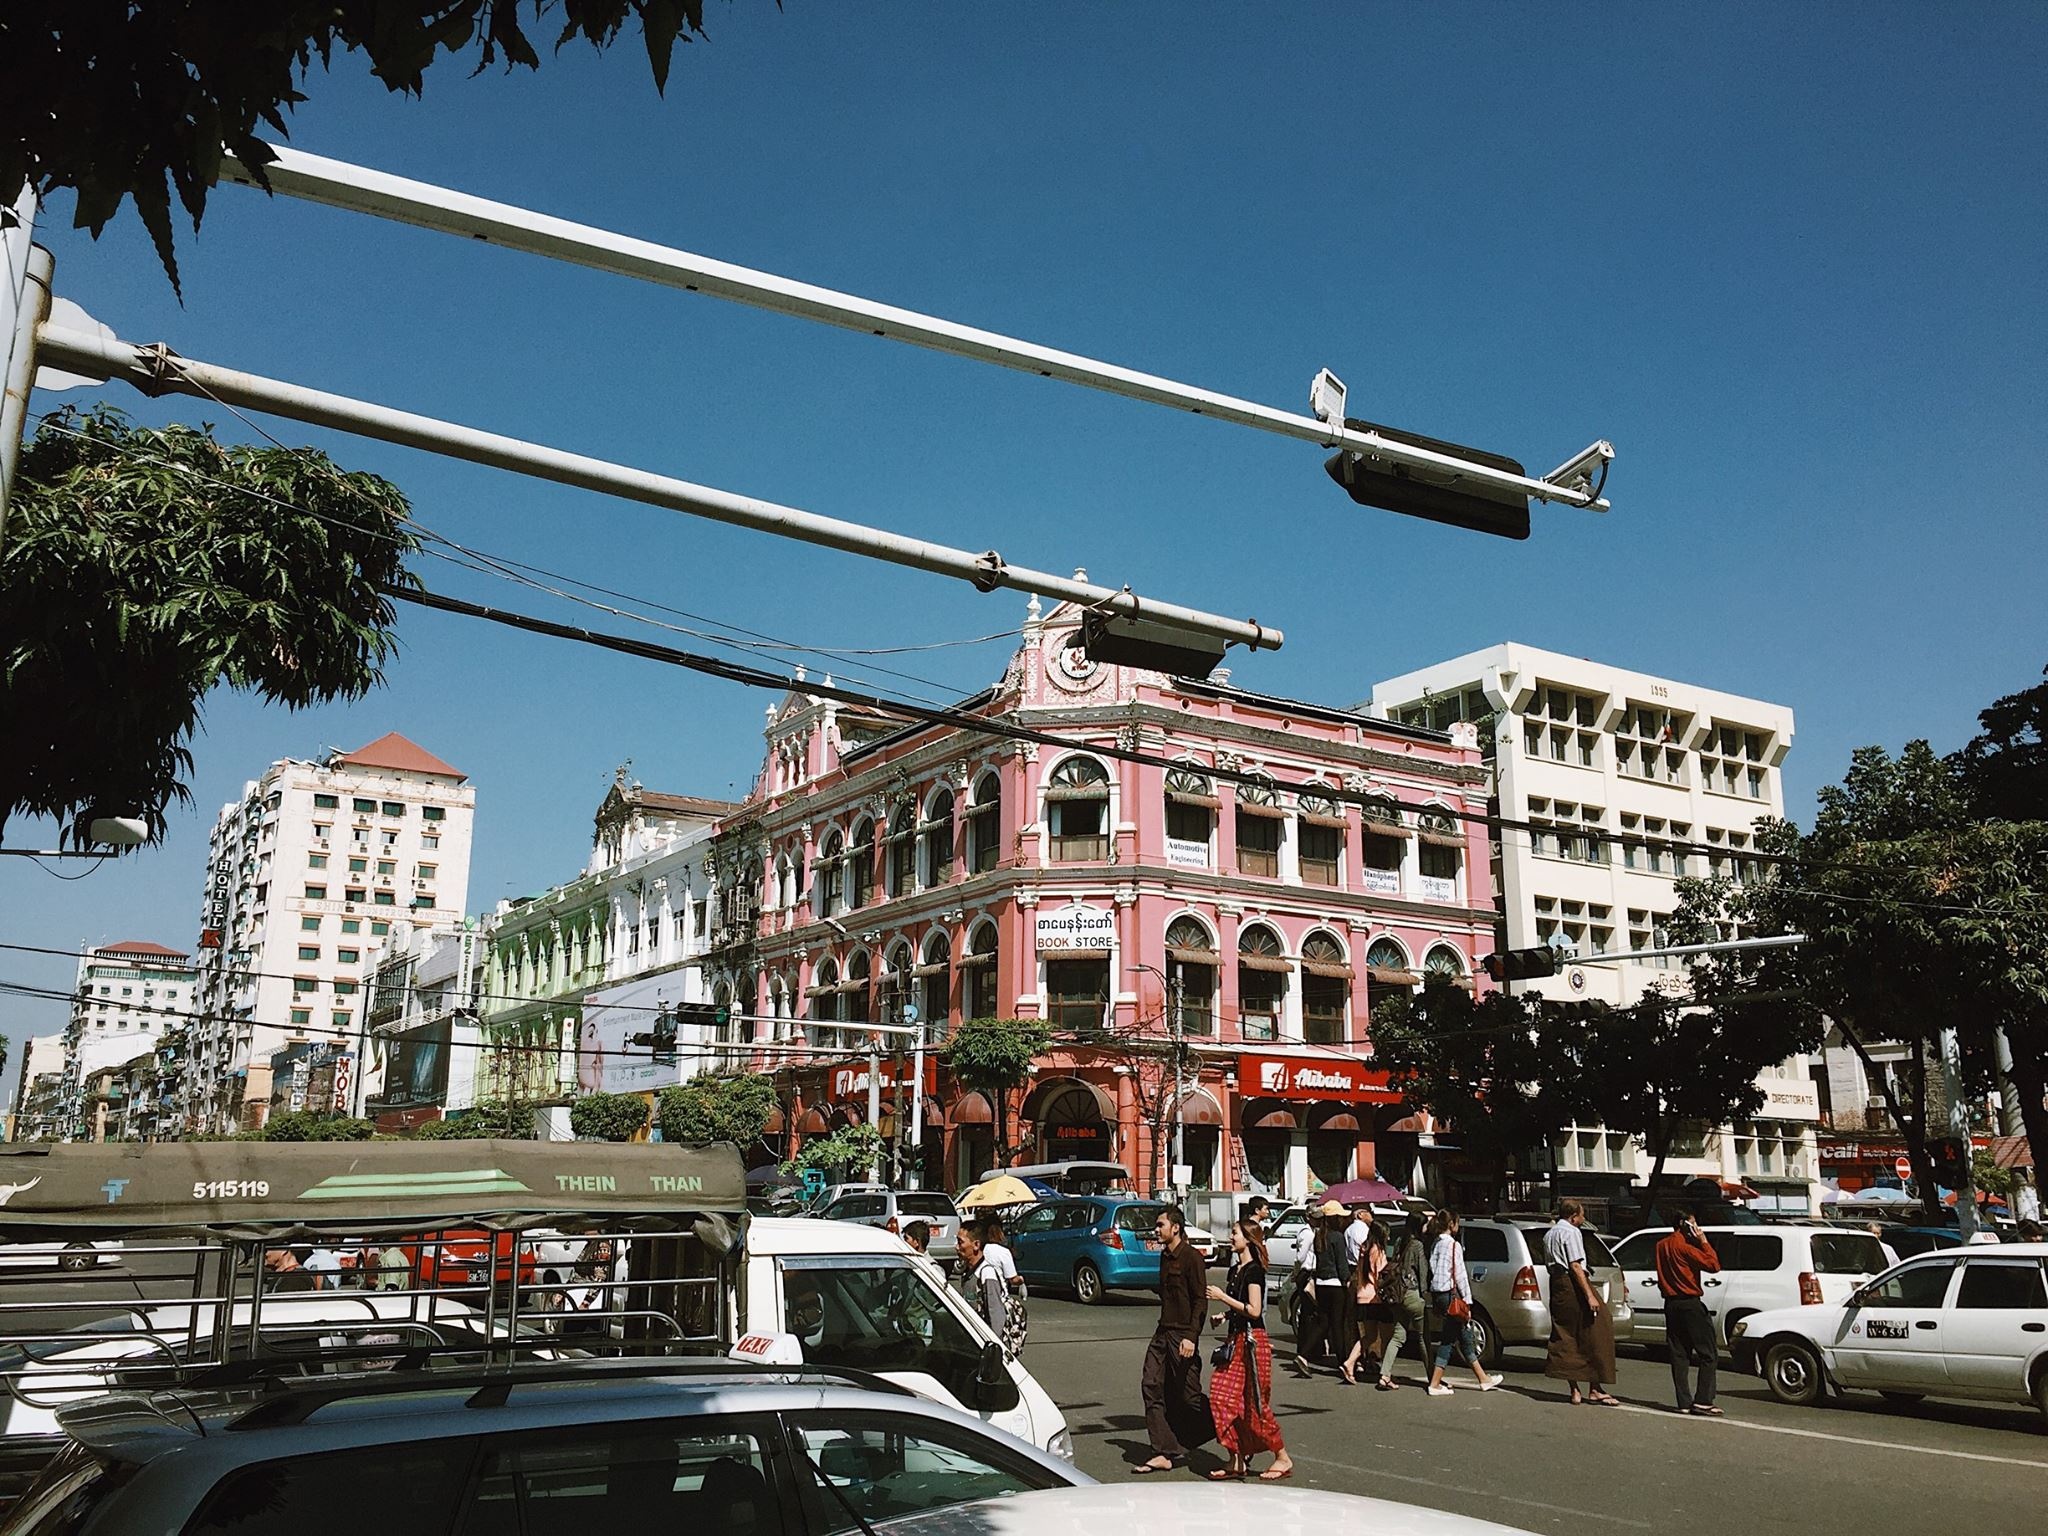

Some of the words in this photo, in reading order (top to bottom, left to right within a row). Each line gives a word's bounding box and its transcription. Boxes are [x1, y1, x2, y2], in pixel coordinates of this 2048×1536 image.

[1168, 841, 1207, 854] Automotive
[213, 861, 229, 927] HOTEL
[1038, 912, 1113, 933] စာပေနန်းတော်
[202, 931, 222, 947] K
[1038, 937, 1070, 948] BOOK
[1075, 936, 1113, 947] STORE
[1293, 1068, 1352, 1090] Alibaba
[1772, 1093, 1813, 1106] DIRECTORATE
[1057, 1126, 1096, 1138] Alibaba
[193, 1180, 270, 1199] 5115119
[555, 1175, 616, 1191] THEIN
[650, 1176, 702, 1191] THAN
[738, 1336, 773, 1355] TAXI
